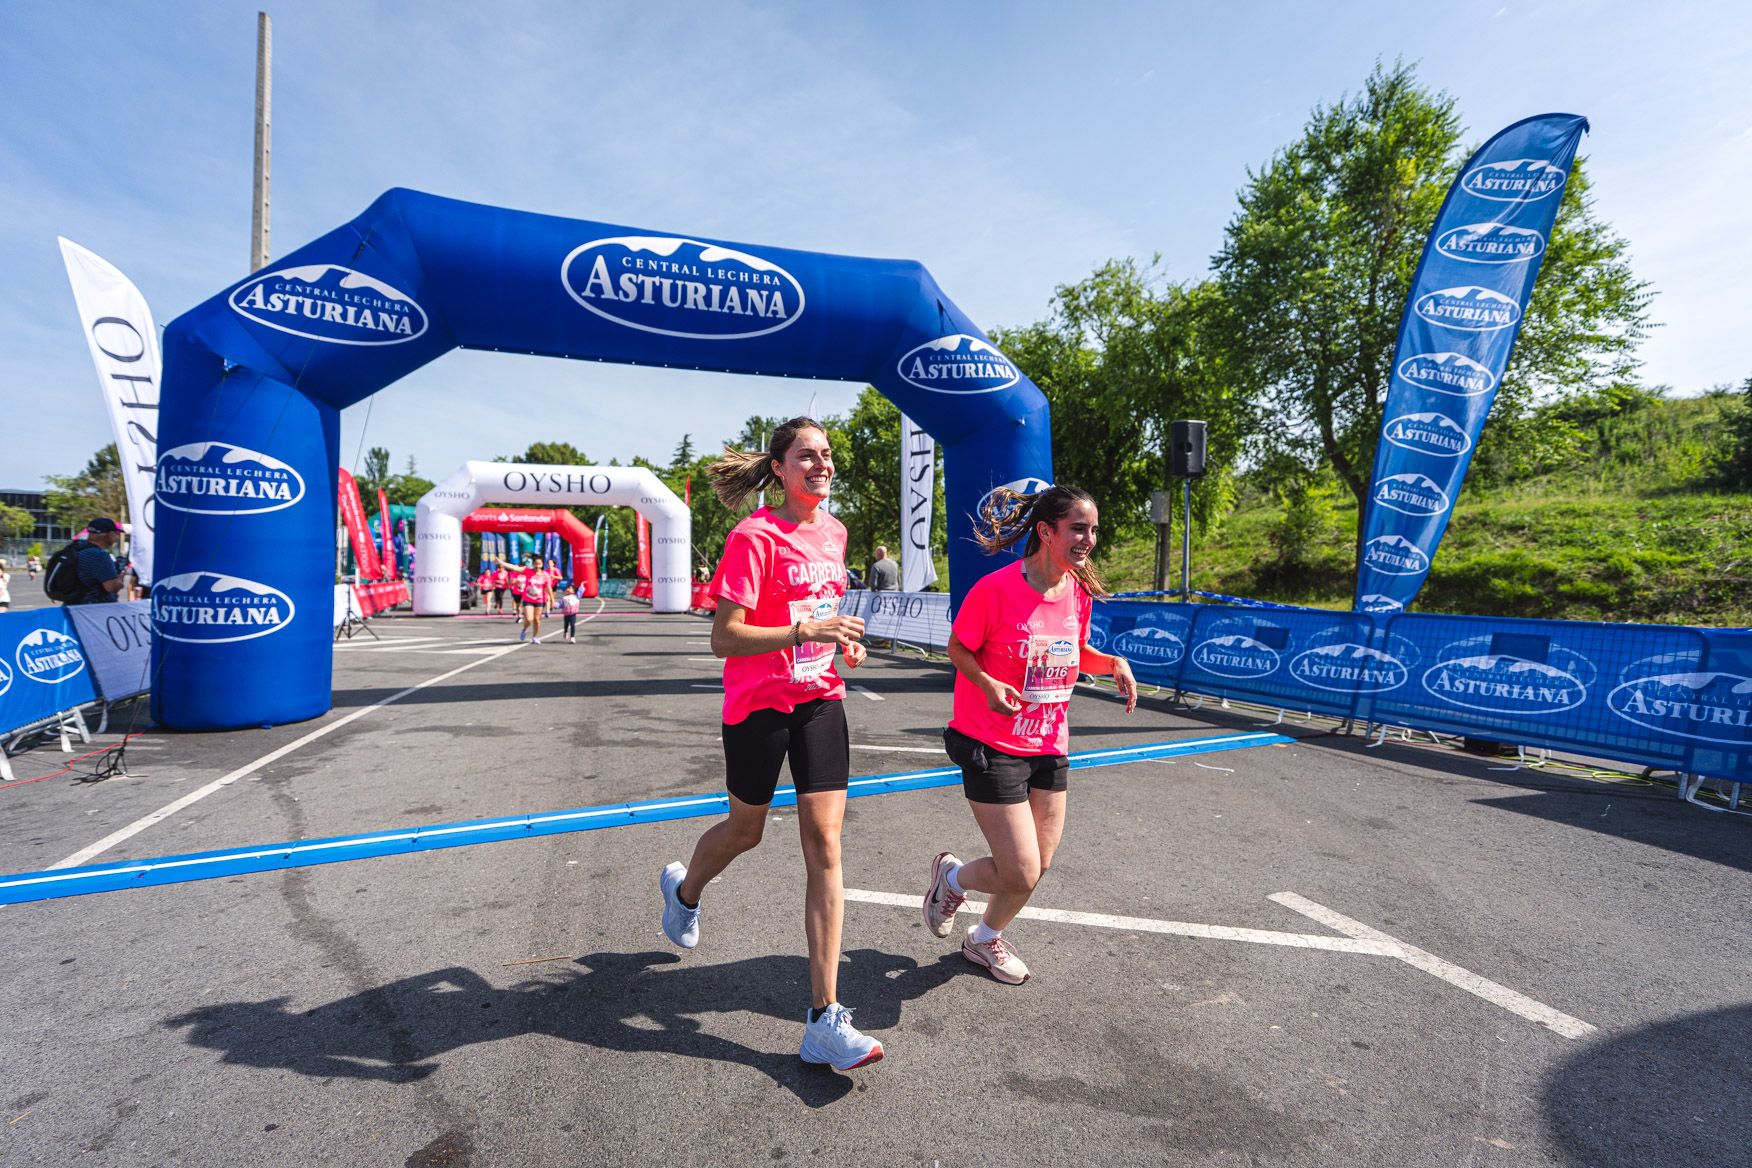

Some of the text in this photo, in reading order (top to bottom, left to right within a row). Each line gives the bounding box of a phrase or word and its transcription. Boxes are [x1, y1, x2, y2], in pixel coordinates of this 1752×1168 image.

[1442, 233, 1535, 255] ASTURIANA
[622, 256, 781, 286] CENTRAL LECHERA
[275, 283, 410, 313] CENTRAL LECHERA
[581, 254, 788, 319] ASTURIANA
[238, 283, 413, 335] ASTURIANA
[1421, 298, 1511, 323] ASTURIANA
[907, 356, 1015, 379] ASTURIANA
[1404, 361, 1485, 391] ASTURIANA
[1390, 422, 1461, 451] ASTURIANA
[156, 465, 293, 501] ASTURIANA
[170, 464, 288, 480] CENTRAL LECHERA
[503, 471, 612, 495] OYSHO
[434, 490, 470, 500] OYSHO
[1376, 483, 1440, 511] ASTURIANA
[509, 513, 552, 523] Santander
[417, 532, 451, 541] OYSHO
[657, 537, 687, 545] OYSHO
[415, 575, 451, 584] OYSHO
[657, 576, 687, 585] OYSHO
[151, 593, 281, 625] ASTURIANA
[162, 594, 277, 605] CENTRAL LECHERA
[870, 595, 924, 619] OYSHO
[1117, 638, 1179, 659] ASTURIANA
[1198, 647, 1271, 671] ASTURIANA
[1046, 666, 1068, 679] 016
[1296, 657, 1396, 685] ASTURIANA
[1432, 669, 1570, 705] ASTURIANA
[1621, 688, 1752, 728] ASTURI
